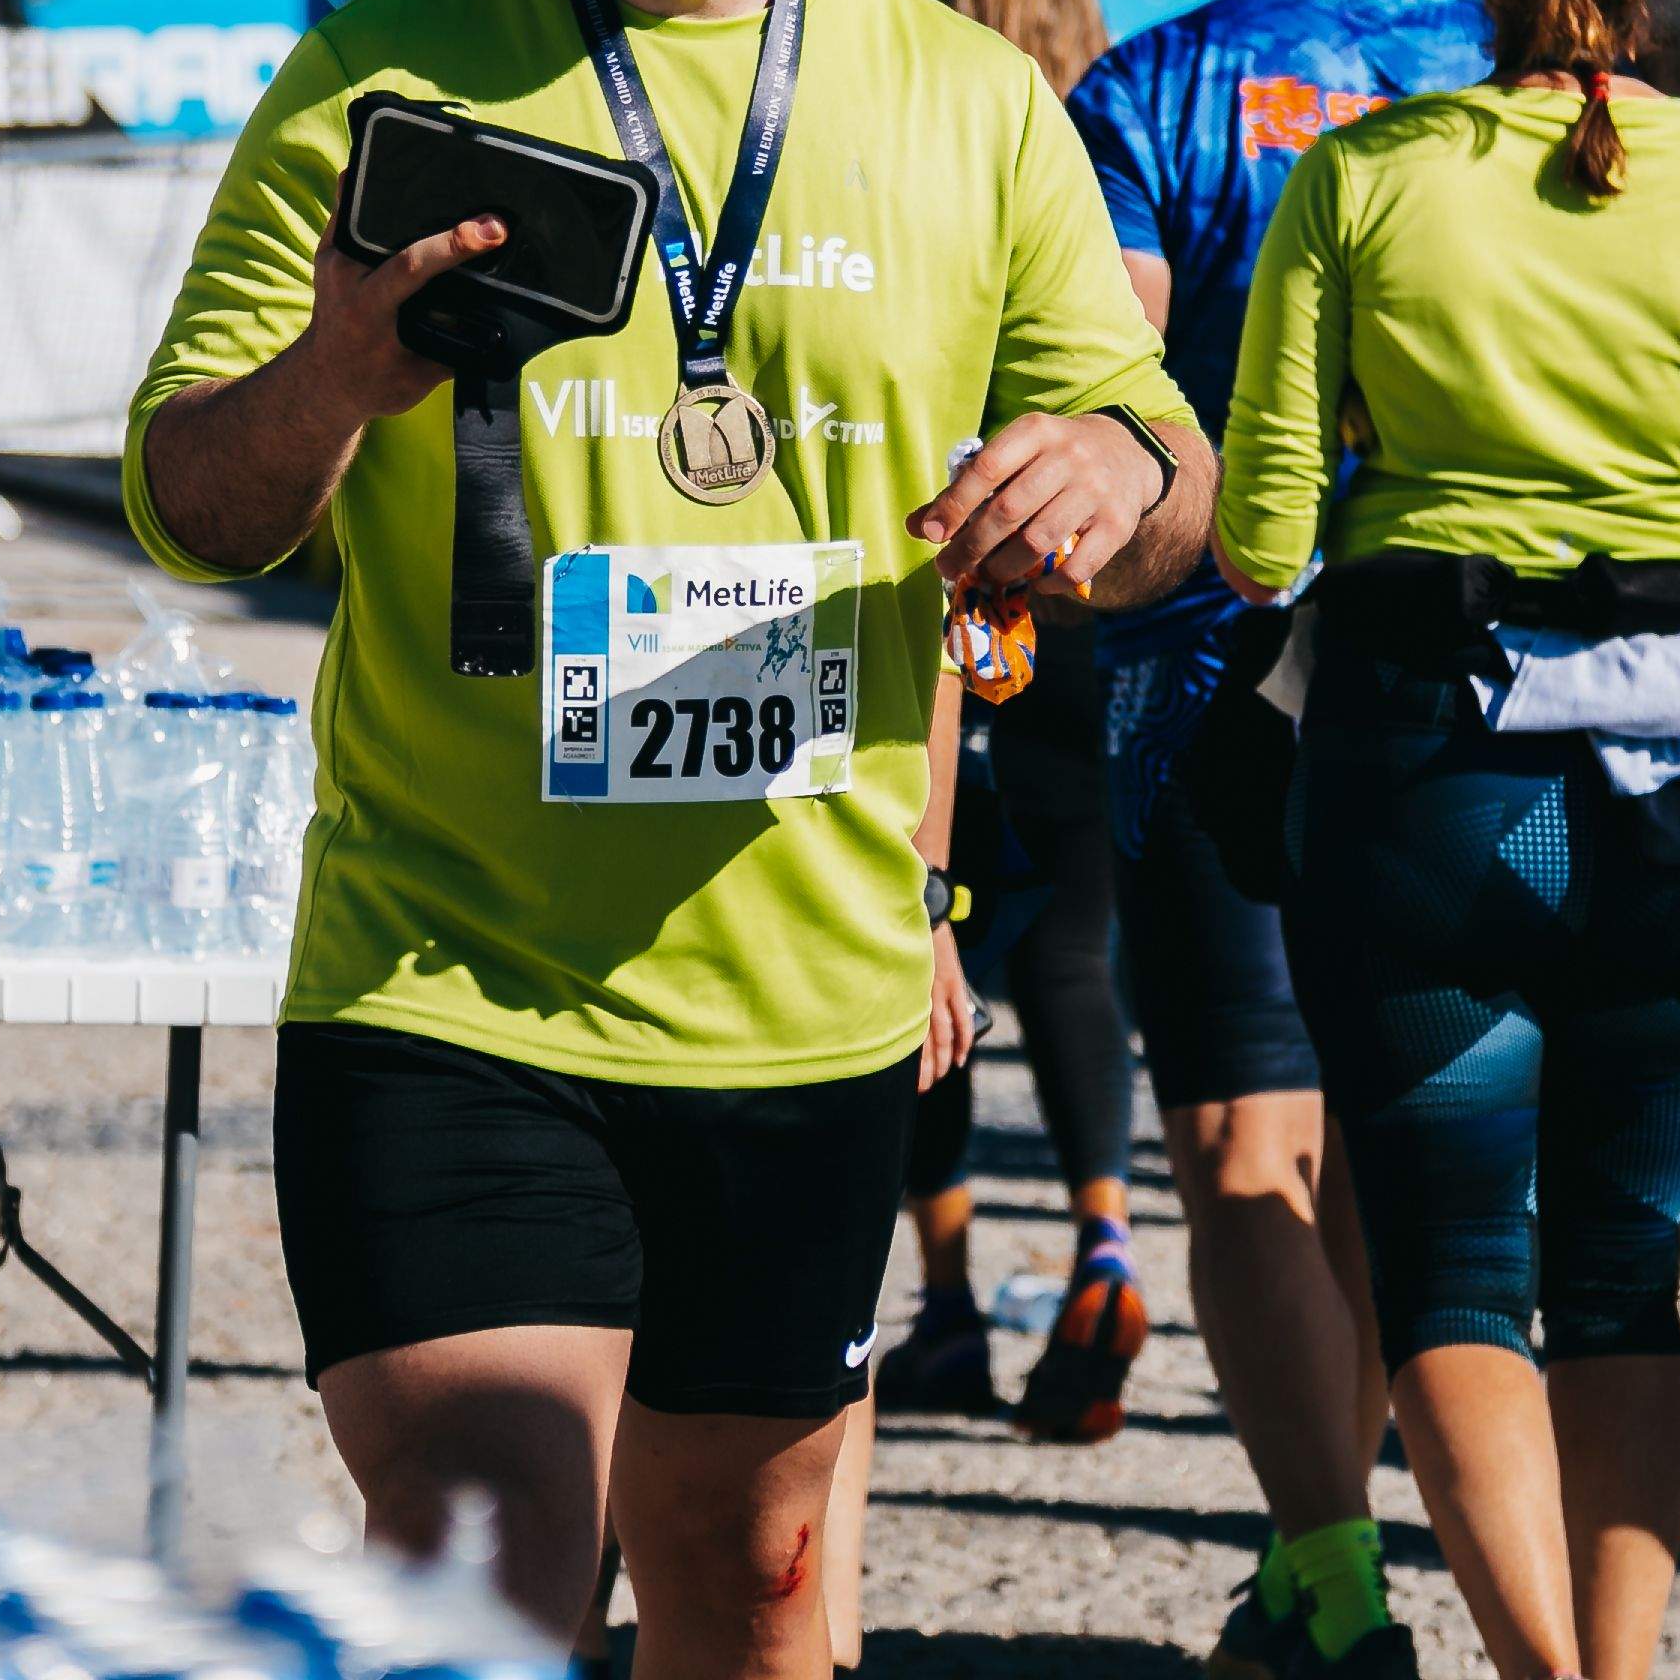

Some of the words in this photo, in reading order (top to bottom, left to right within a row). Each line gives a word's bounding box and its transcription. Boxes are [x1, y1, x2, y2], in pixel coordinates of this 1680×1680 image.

[777, 11, 798, 72] METLIFE
[604, 50, 632, 112] MADRID
[624, 109, 650, 157] ACTIVA
[772, 72, 792, 96] 15K
[759, 96, 782, 151] EDICIÓN
[752, 152, 770, 176] VIII
[704, 262, 737, 326] MetLife
[528, 379, 616, 438] VIII
[621, 414, 658, 438] 15K
[695, 464, 752, 486] MetLife
[686, 578, 804, 607] MetLife
[627, 633, 658, 653] VIII
[629, 694, 796, 778] 2738
